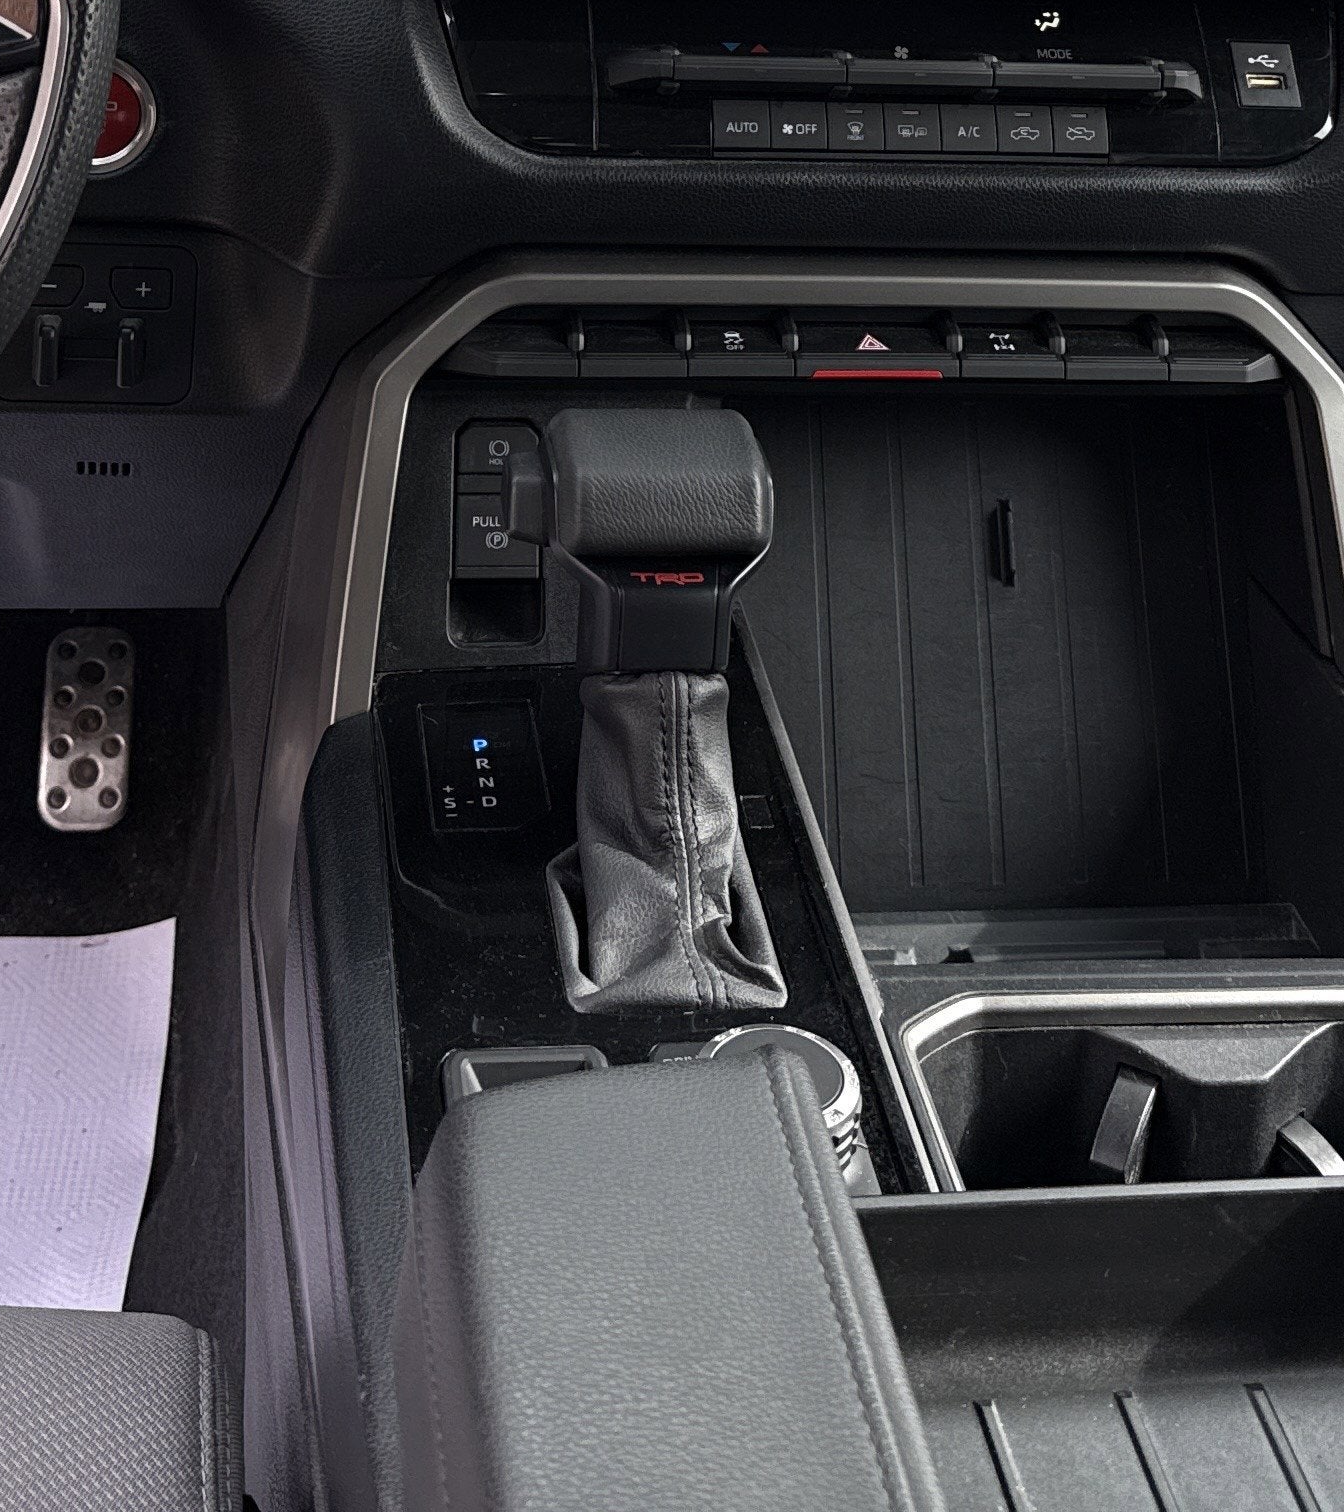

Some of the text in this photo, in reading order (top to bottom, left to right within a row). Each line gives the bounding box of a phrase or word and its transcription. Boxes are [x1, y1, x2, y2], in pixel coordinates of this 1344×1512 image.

[1036, 47, 1075, 61] MODE
[725, 120, 759, 134] AUTO
[795, 122, 818, 136] OFF
[957, 125, 981, 139] A/C
[472, 515, 502, 528] PULL
[629, 571, 705, 586] TRD
[472, 739, 488, 752] P
[475, 757, 492, 770] R
[478, 776, 495, 788] N
[443, 797, 457, 809] S
[482, 795, 498, 808] D
